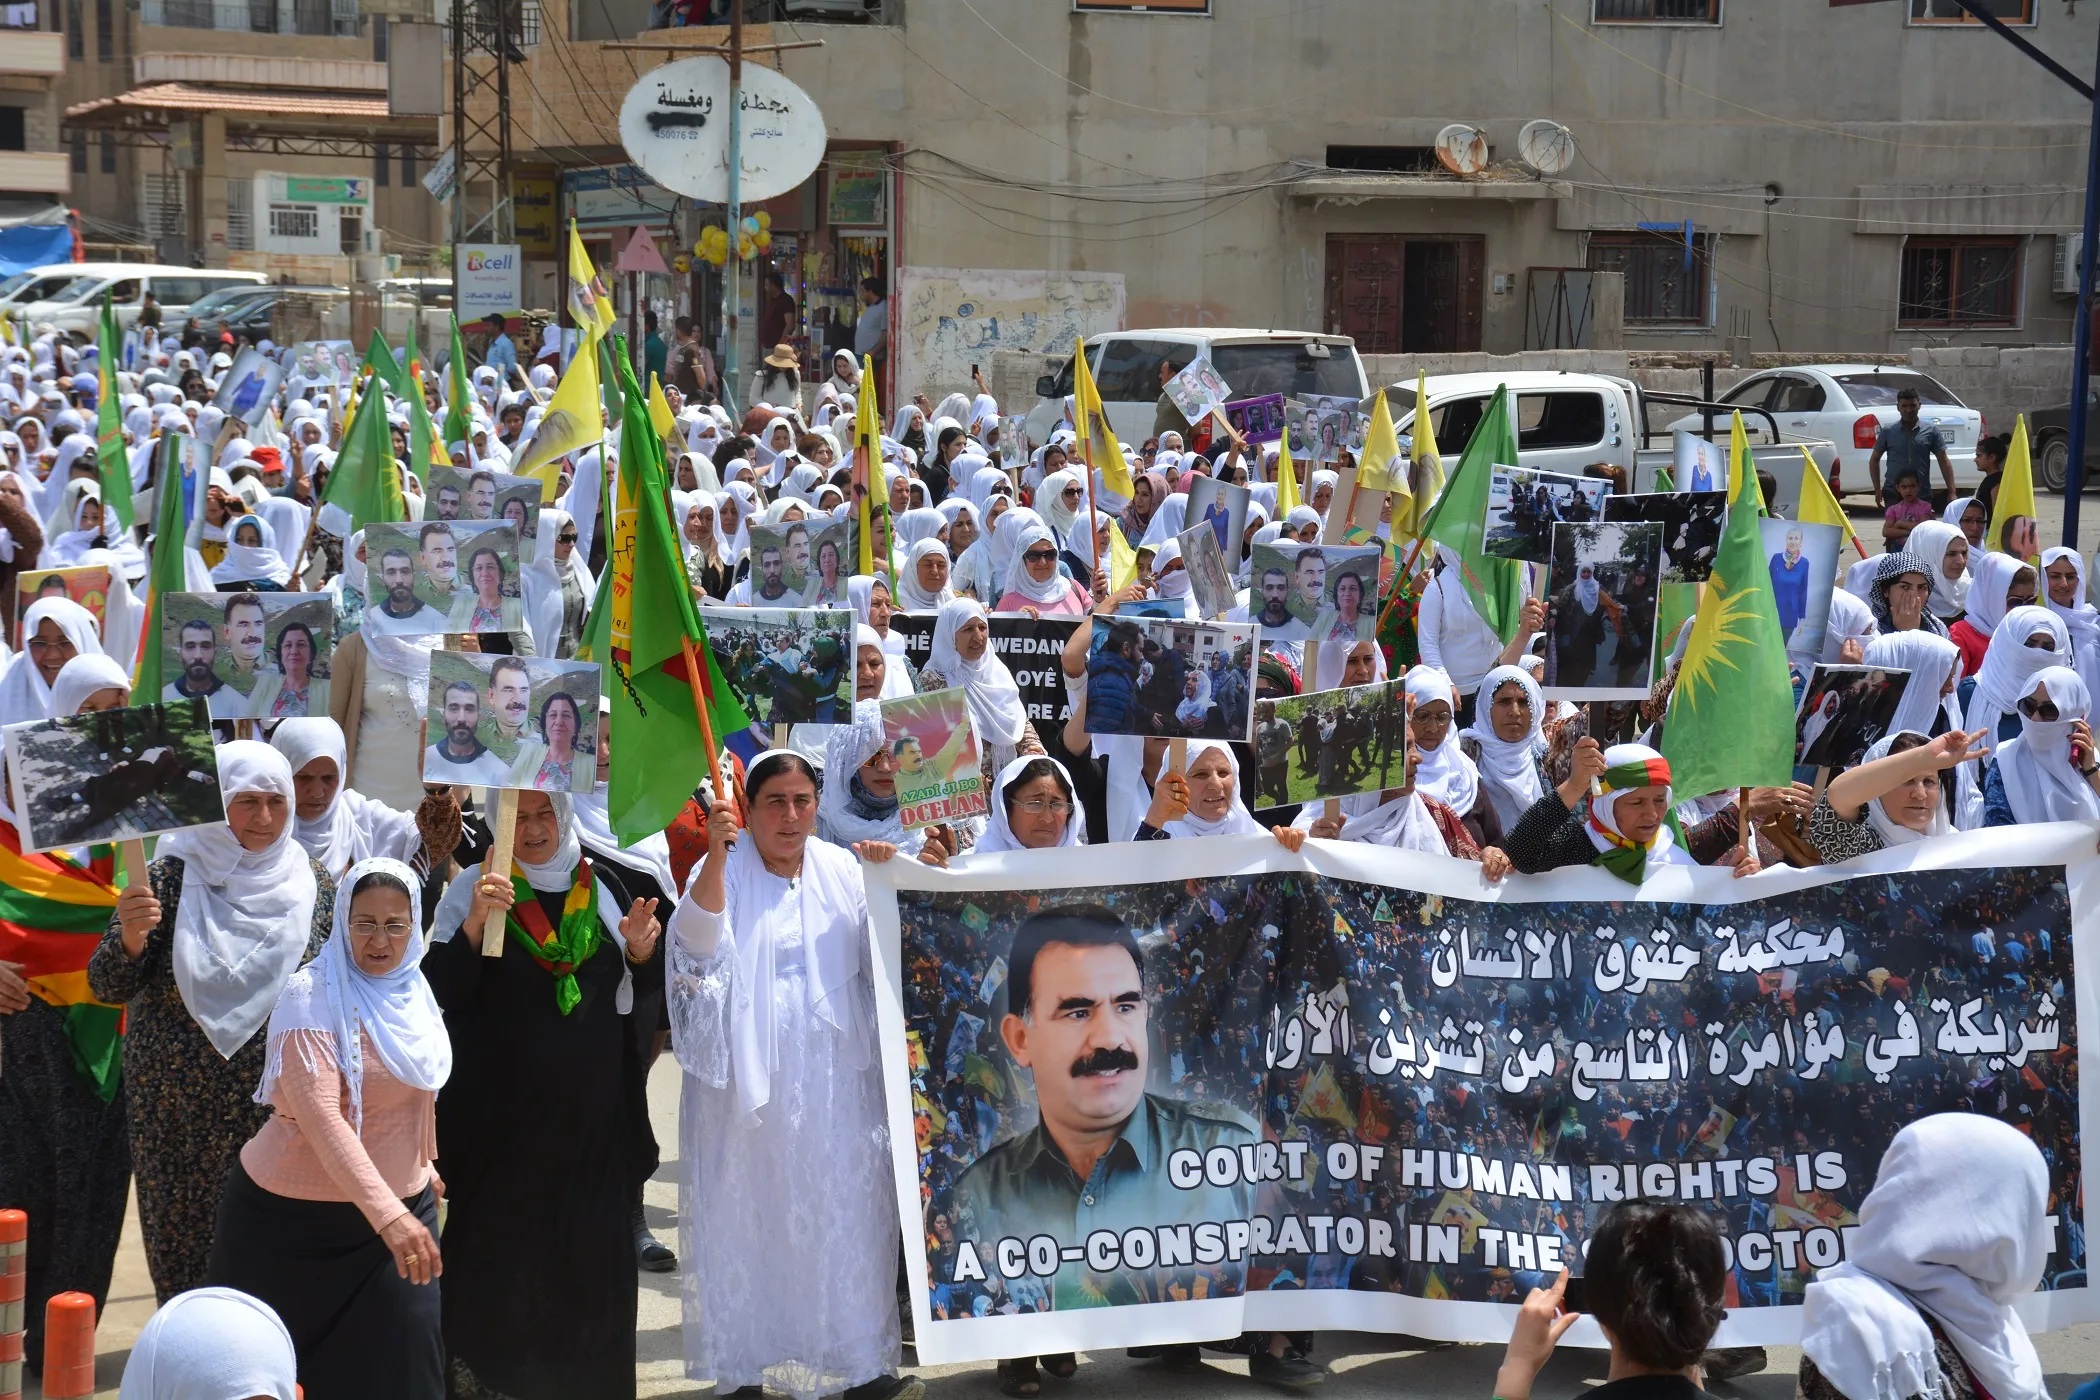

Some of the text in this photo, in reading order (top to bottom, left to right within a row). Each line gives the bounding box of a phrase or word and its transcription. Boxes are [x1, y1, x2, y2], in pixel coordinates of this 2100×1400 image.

[657, 82, 712, 114] ومغسلة
[988, 637, 1065, 656] WEDAN
[1015, 667, 1057, 687] OYÊ
[901, 777, 979, 804] AZADÎ JI BO
[900, 791, 987, 826] OCELAN
[1431, 917, 1846, 994] محكمة حقوق الانسان
[1265, 992, 2061, 1101] شريكة في مؤامرة التاسع من تشرين الأول
[1167, 1140, 1848, 1203] COURT OF HUMAN RIGHTS IS
[952, 1240, 987, 1283] A
[996, 1214, 1397, 1280] CO-CONSPRATOR
[1409, 1222, 1461, 1267] IN
[1477, 1226, 1566, 1274] THE
